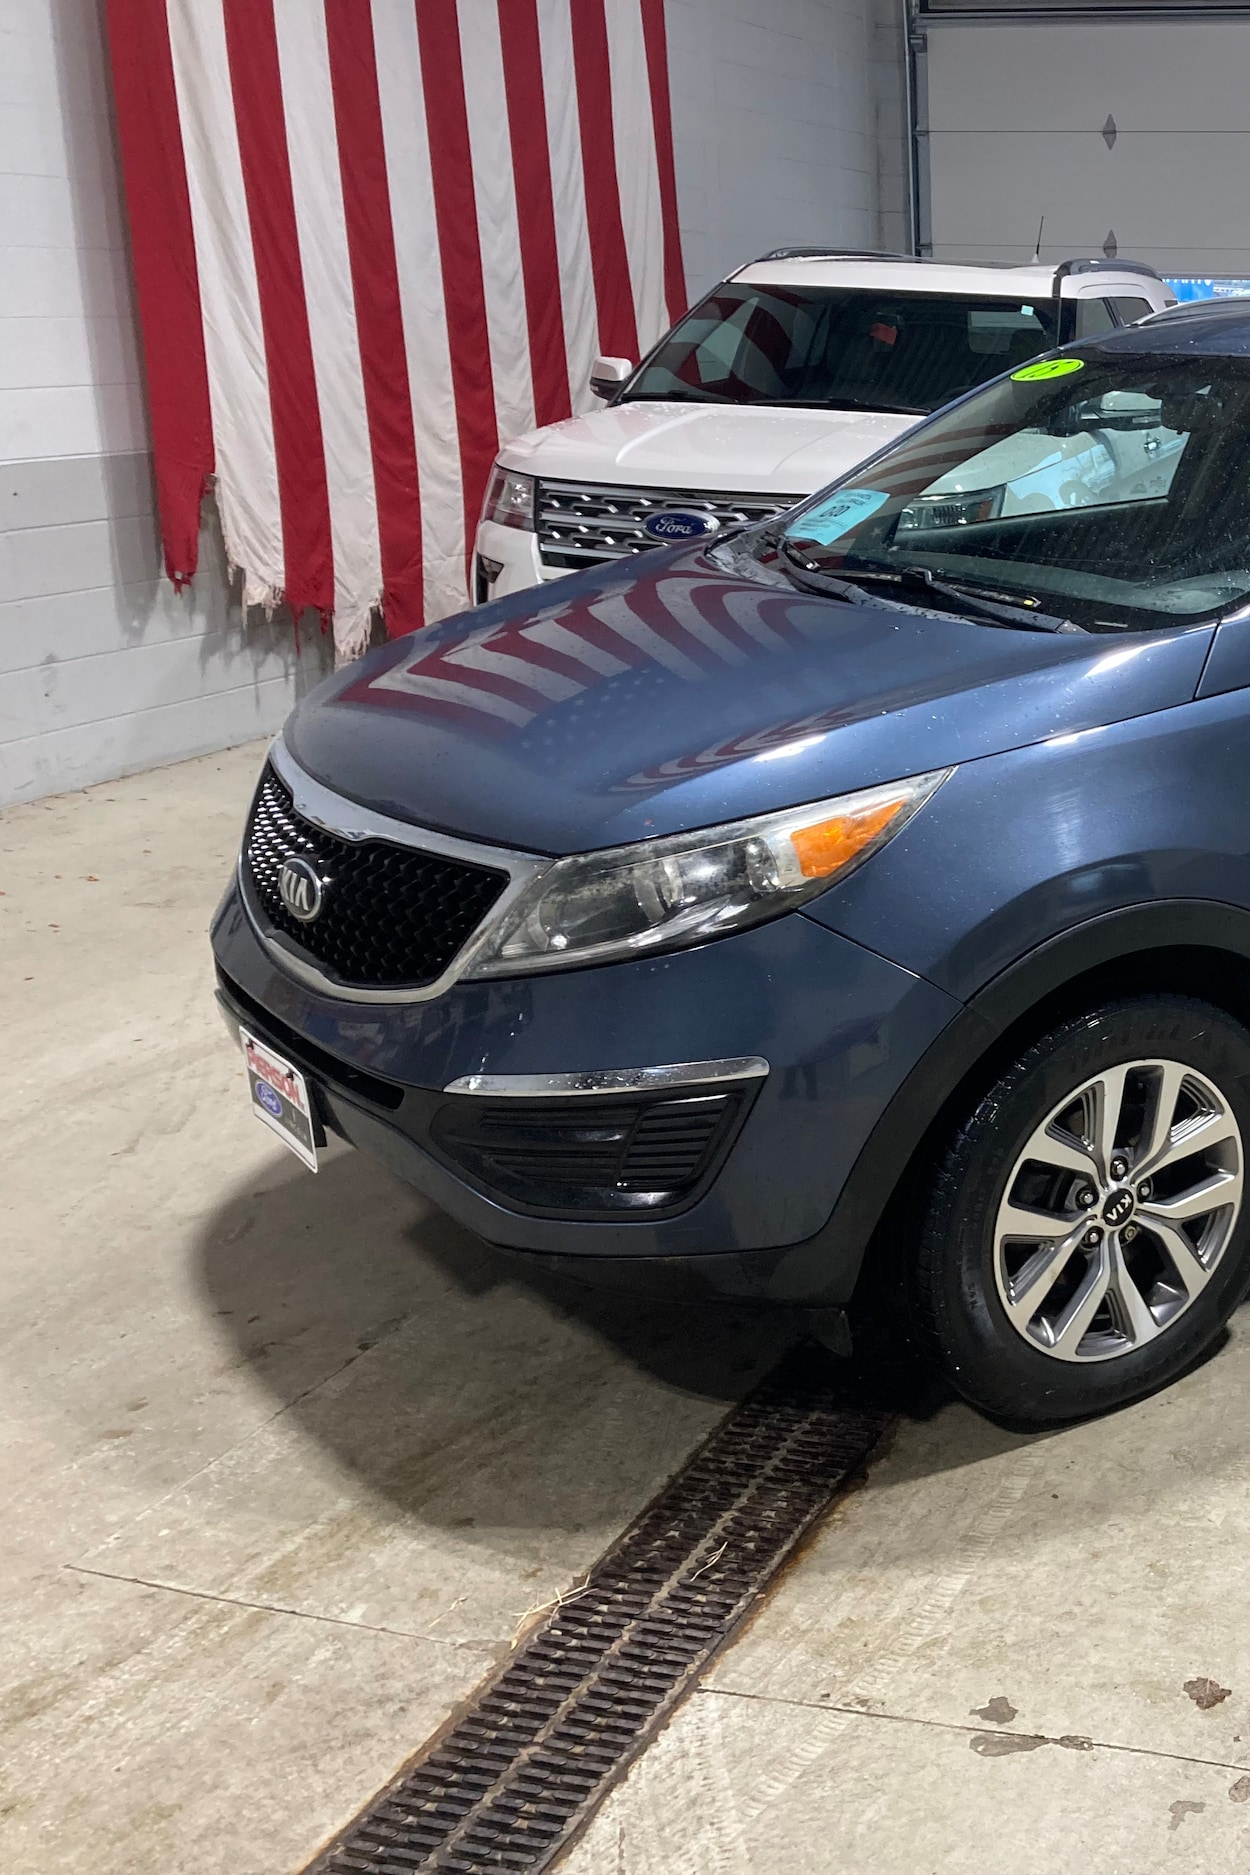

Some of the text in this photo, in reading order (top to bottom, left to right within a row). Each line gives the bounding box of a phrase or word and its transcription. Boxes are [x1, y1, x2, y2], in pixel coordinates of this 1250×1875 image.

[655, 516, 695, 535] Ford
[280, 866, 309, 911] KIA
[1106, 1193, 1132, 1220] KIA
